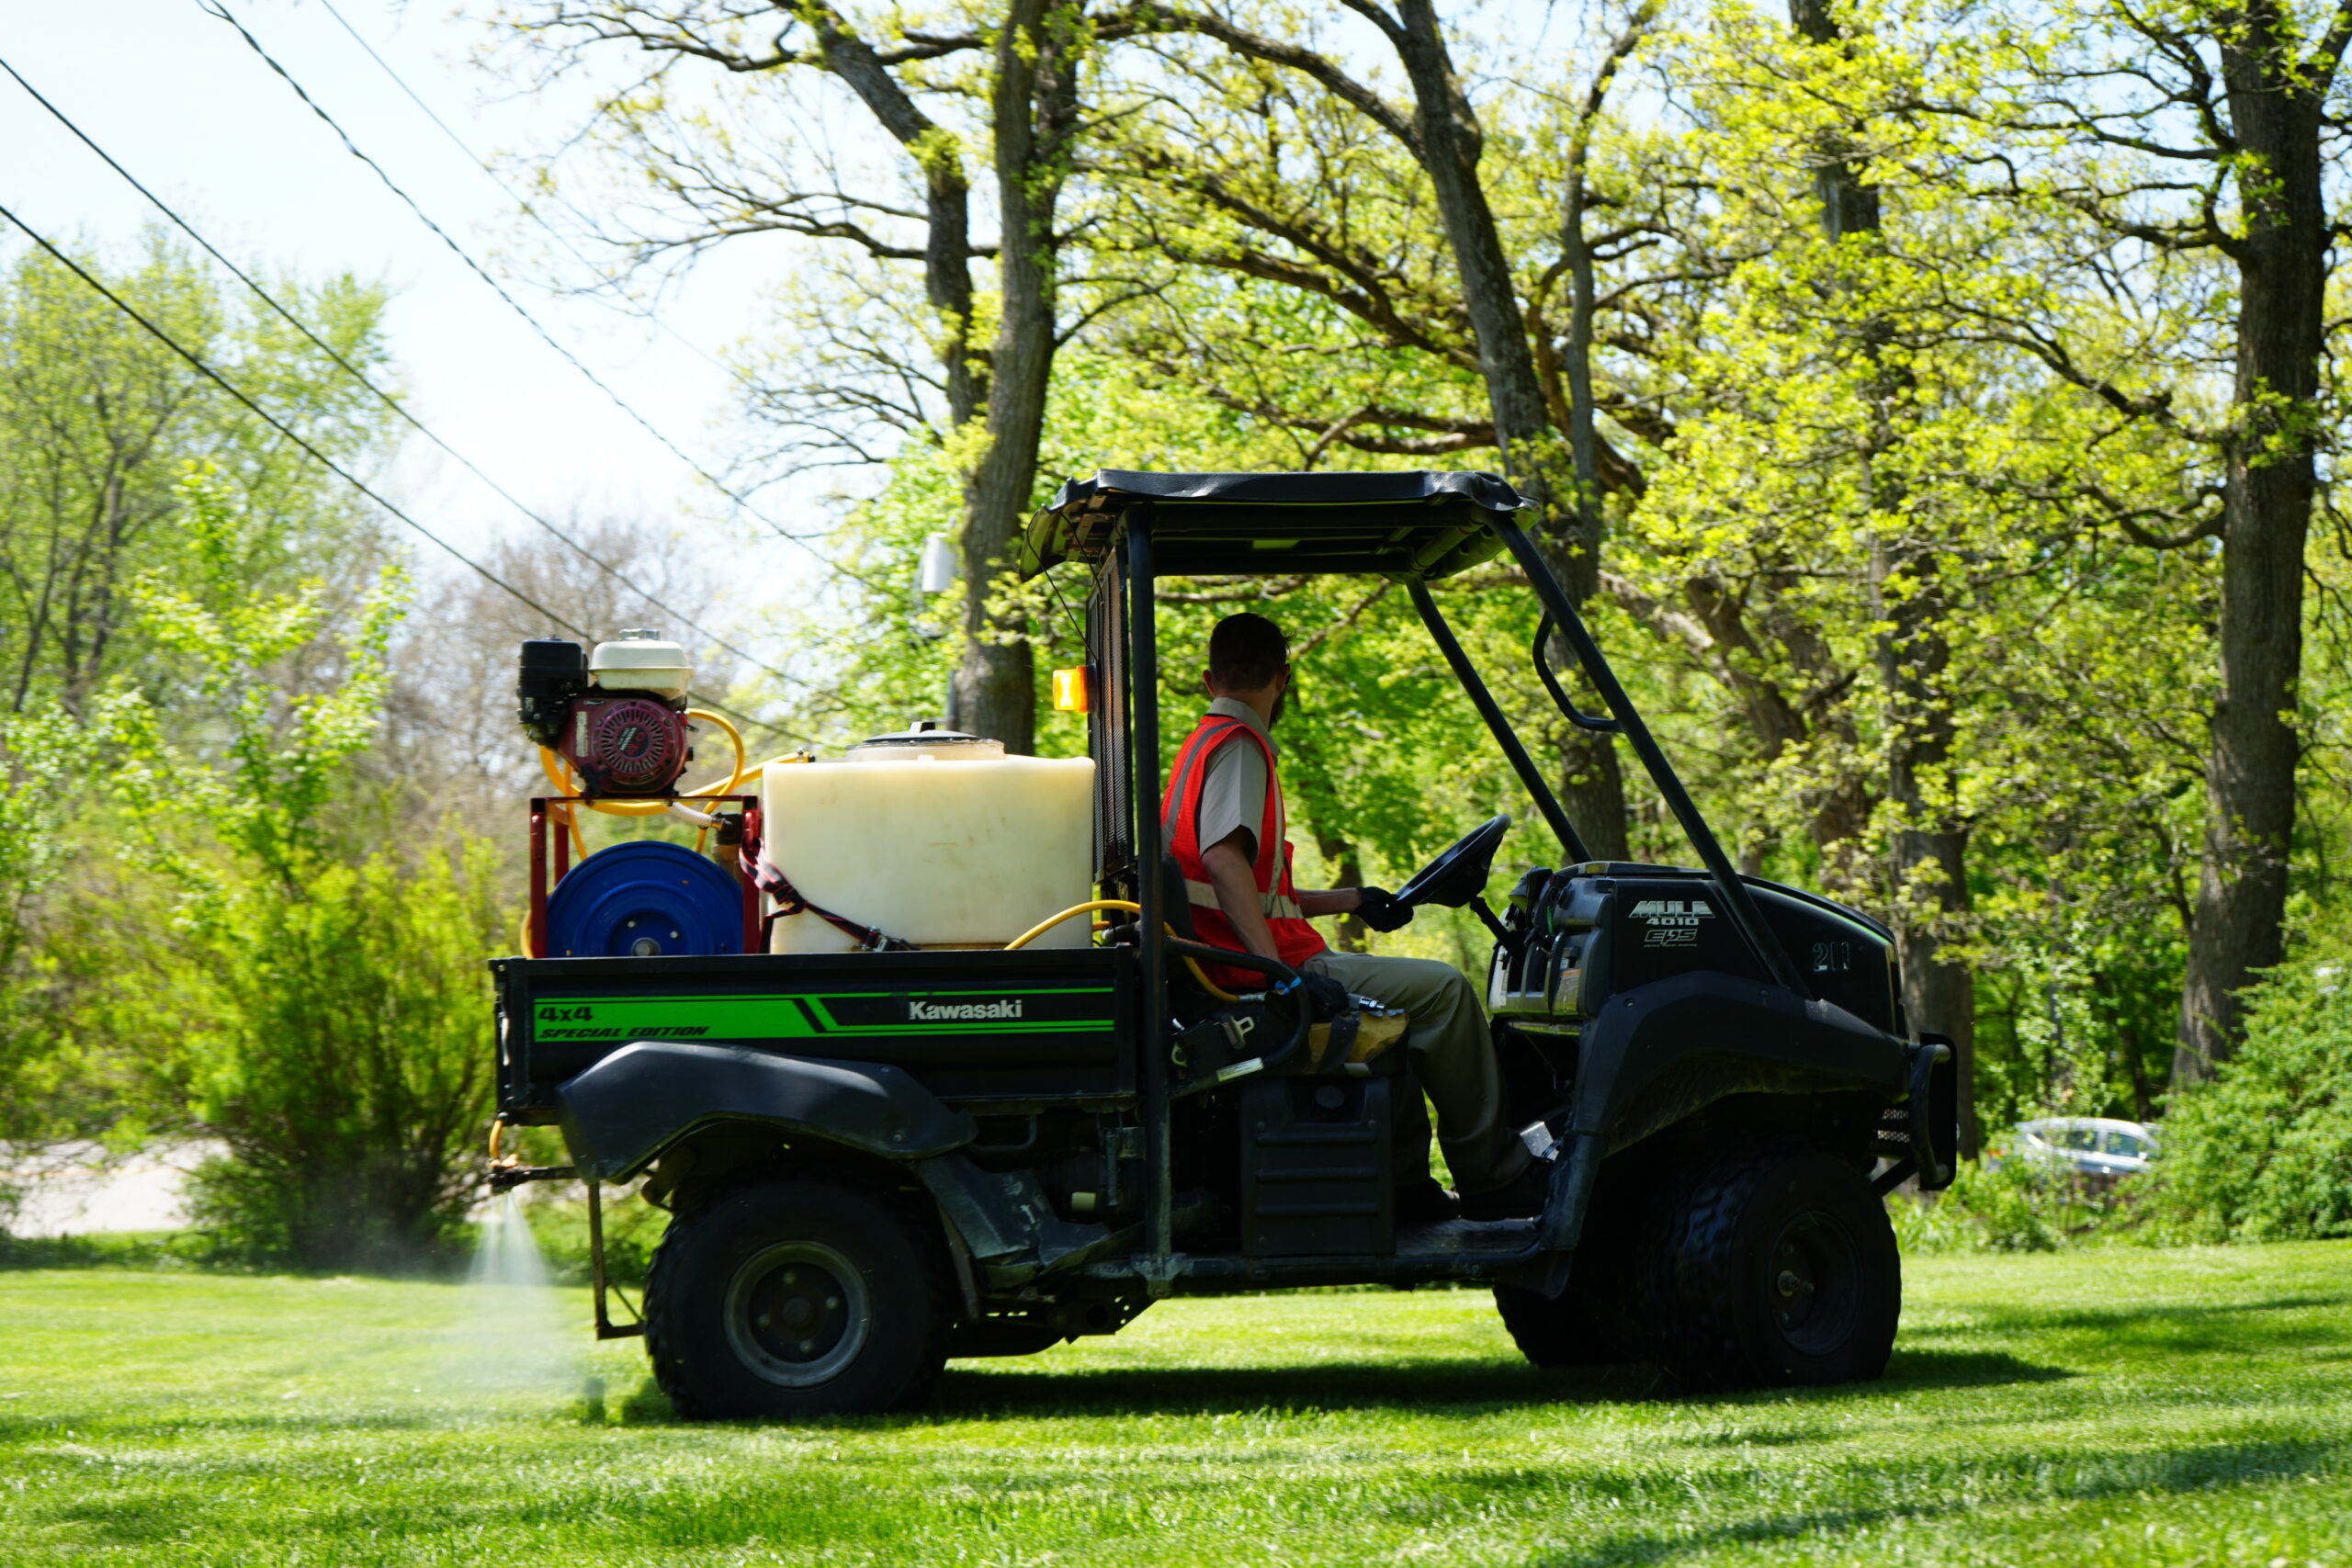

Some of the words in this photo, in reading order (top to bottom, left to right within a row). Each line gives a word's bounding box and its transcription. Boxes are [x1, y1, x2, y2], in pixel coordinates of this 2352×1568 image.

[1628, 900, 1716, 919] MULE
[1645, 918, 1700, 926] 4010
[1644, 928, 1698, 944] EPS
[537, 1006, 594, 1022] 4x4
[908, 998, 1023, 1021] Kawasaki
[538, 1027, 622, 1039] SPECIAL
[626, 1025, 710, 1038] EDITION
